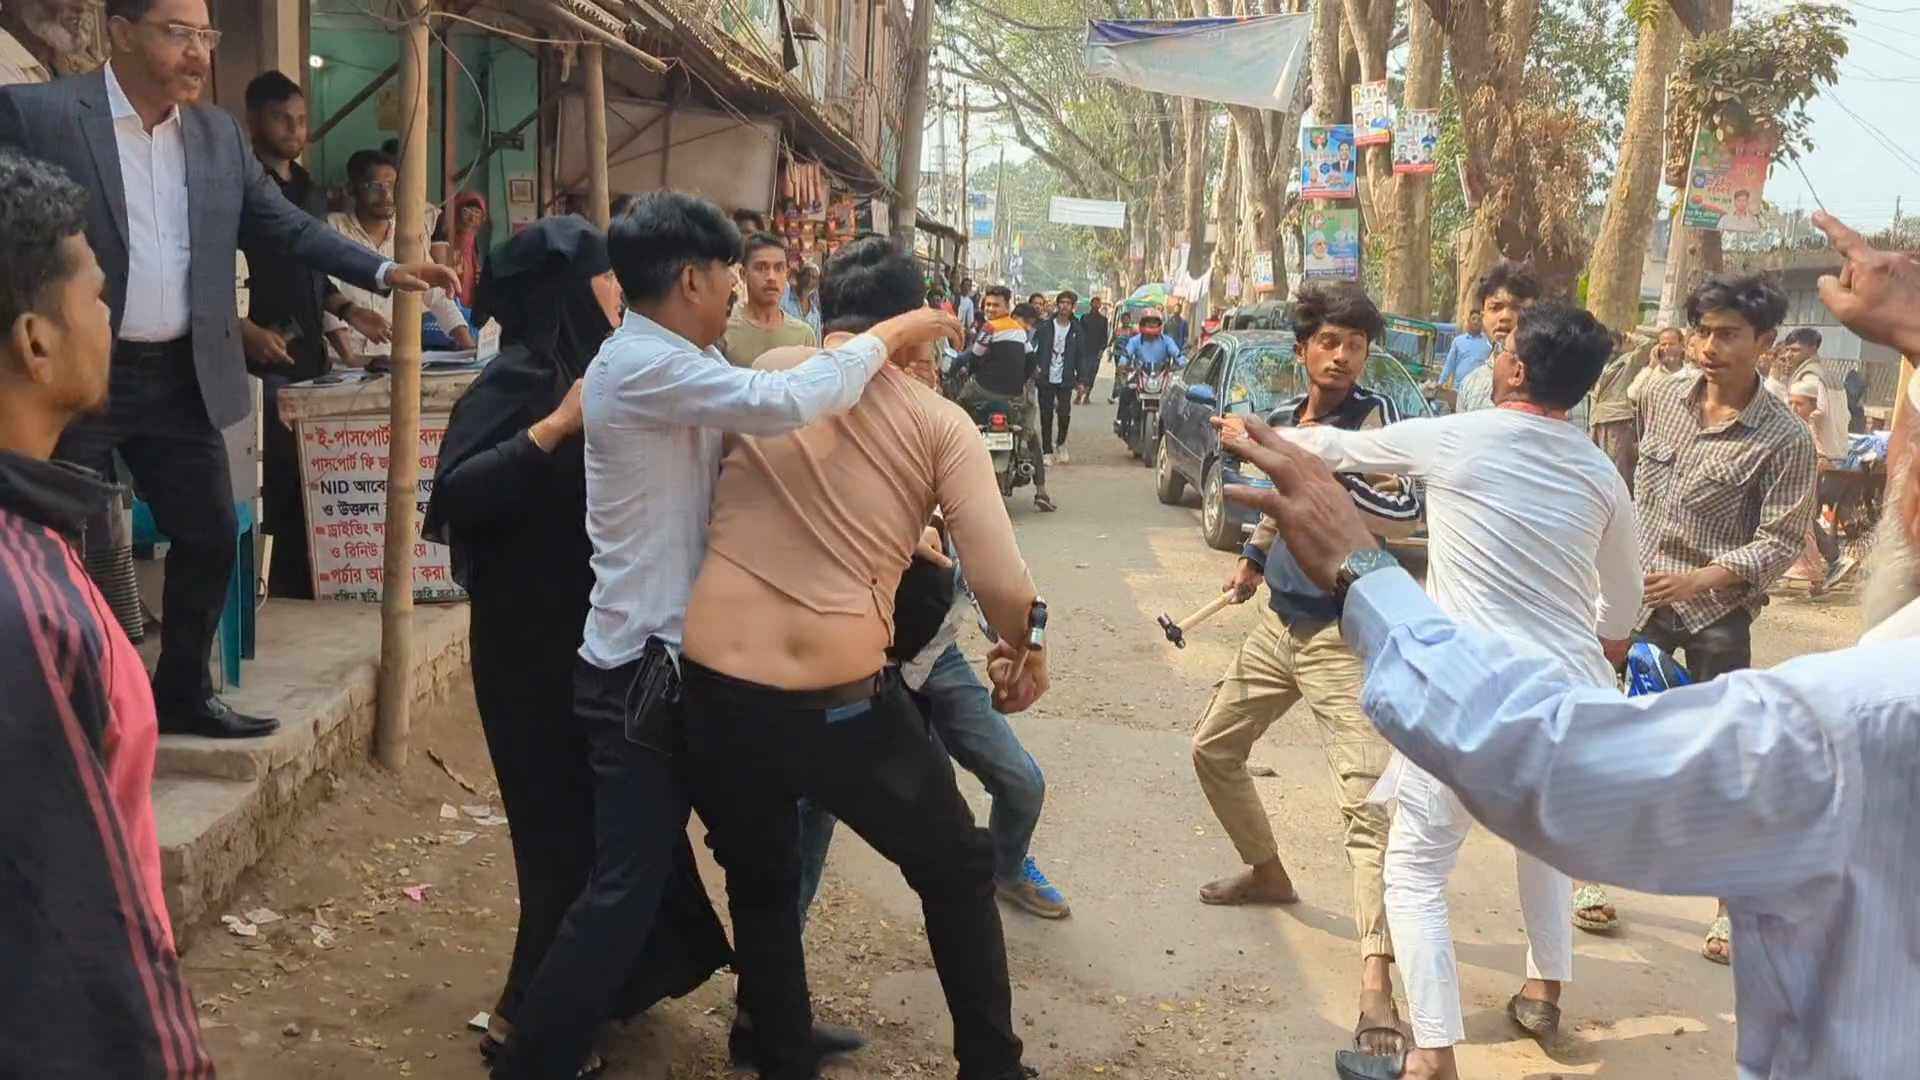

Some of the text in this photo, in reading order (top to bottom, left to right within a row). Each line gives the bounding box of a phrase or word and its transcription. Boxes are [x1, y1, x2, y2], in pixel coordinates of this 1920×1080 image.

[311, 452, 356, 472] পাসপোর্ট
[360, 452, 374, 470] ফি
[320, 480, 386, 494] NID আবে
[322, 504, 334, 516] ও
[330, 547, 340, 558] ও
[419, 565, 446, 582] করা
